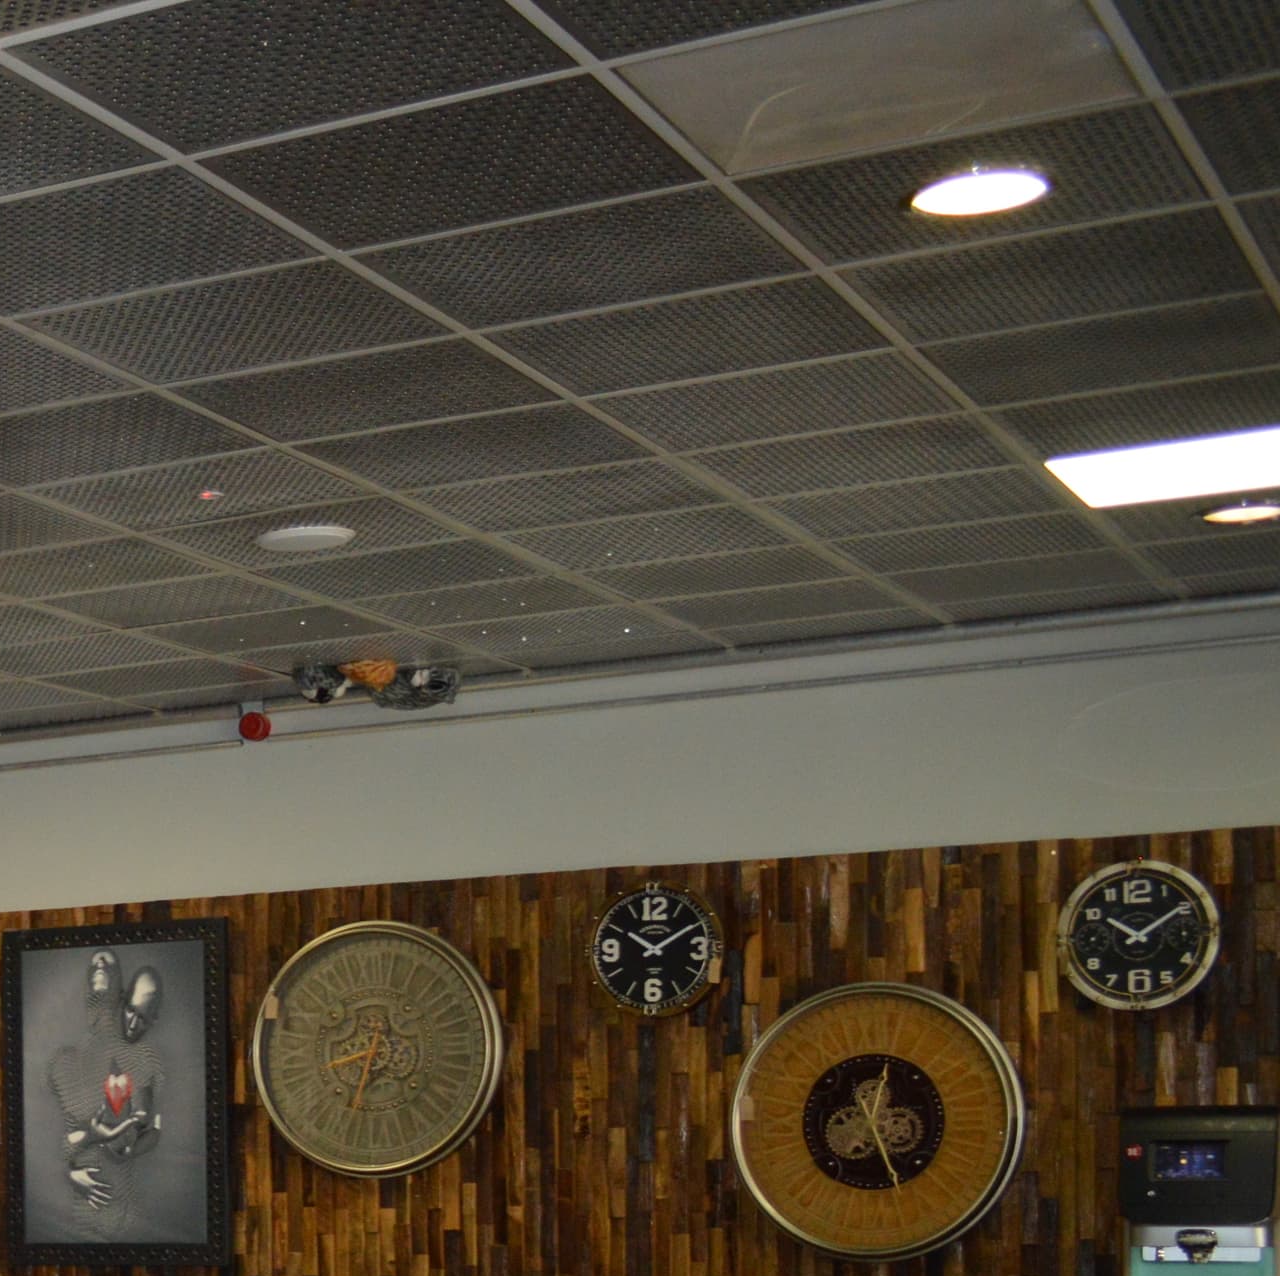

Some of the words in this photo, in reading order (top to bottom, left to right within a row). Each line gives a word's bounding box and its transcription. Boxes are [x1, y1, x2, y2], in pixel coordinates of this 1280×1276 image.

[1104, 888, 1117, 901] 11
[1123, 880, 1152, 904] 12
[1160, 885, 1168, 897] 1
[642, 897, 668, 920] 12
[1086, 908, 1101, 920] 10
[1178, 902, 1191, 914] 2
[601, 938, 620, 962] 9
[690, 936, 708, 960] 3
[1087, 958, 1100, 969] 8
[1181, 952, 1193, 964] 4
[1106, 974, 1118, 987] 7
[1128, 969, 1152, 993] 6
[1160, 971, 1174, 983] 5
[644, 978, 662, 1002] 6
